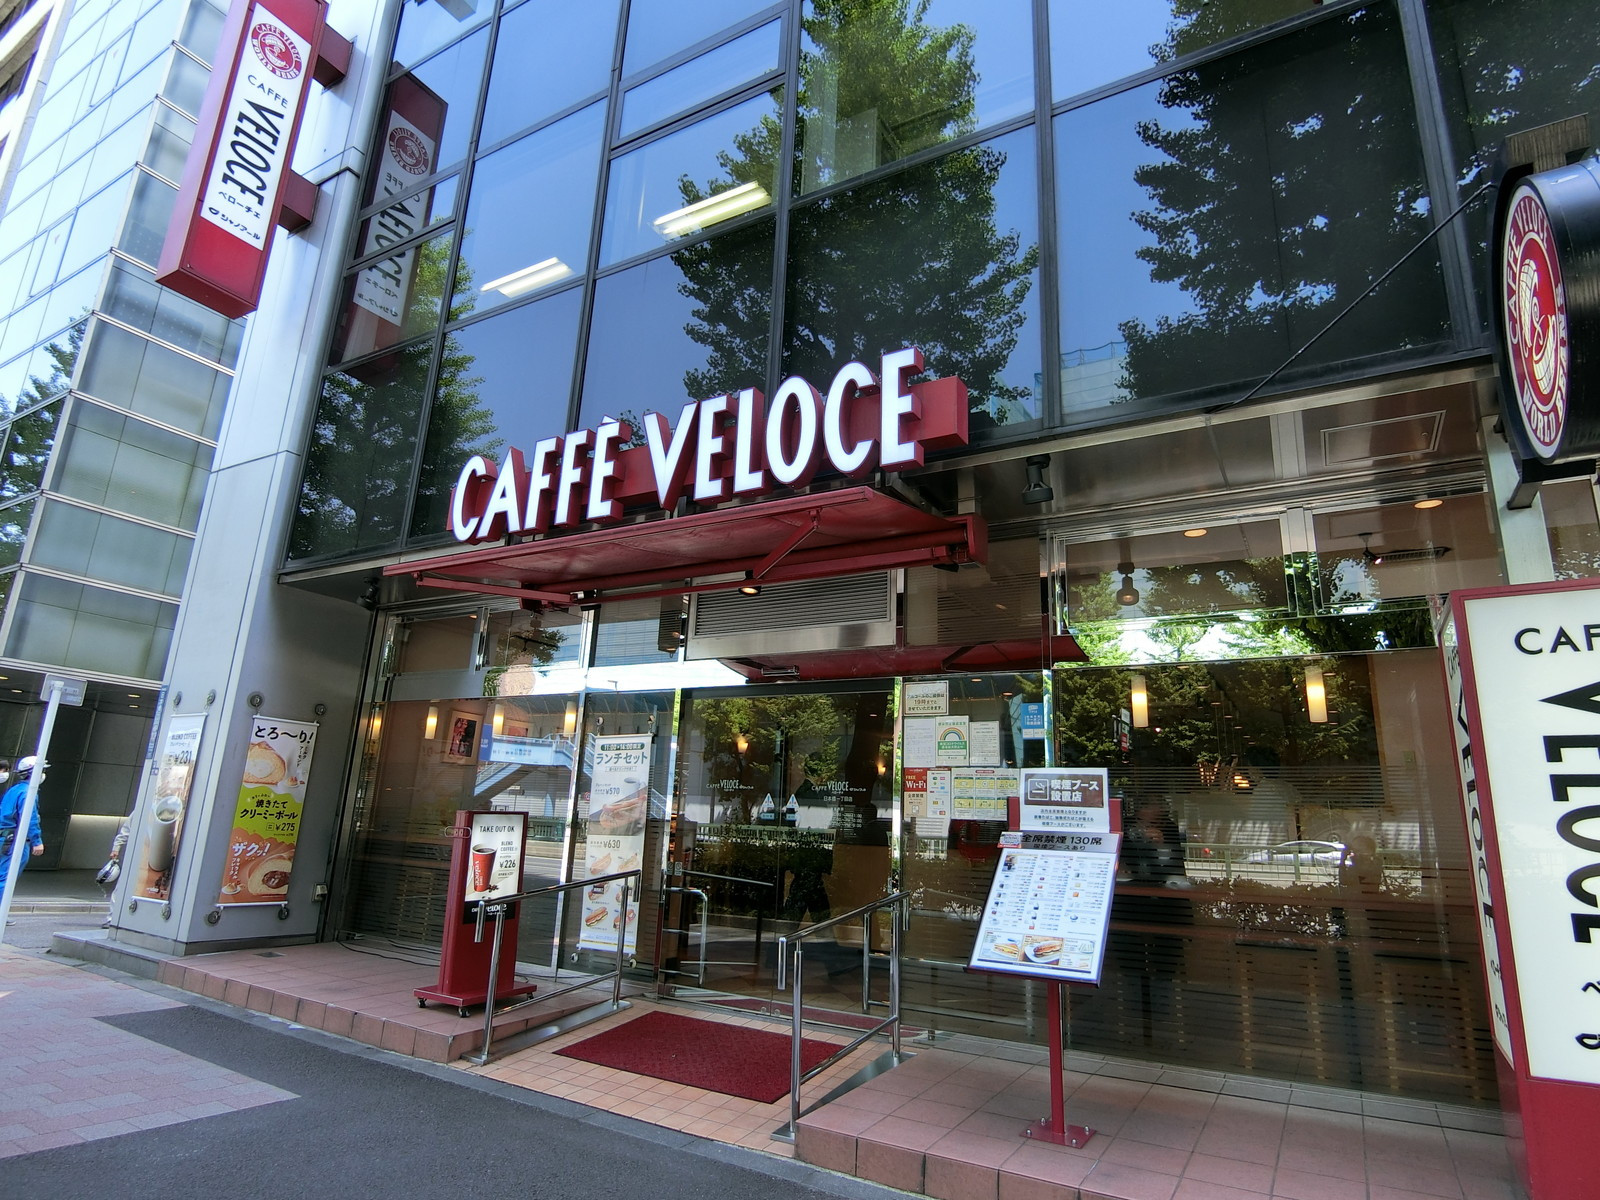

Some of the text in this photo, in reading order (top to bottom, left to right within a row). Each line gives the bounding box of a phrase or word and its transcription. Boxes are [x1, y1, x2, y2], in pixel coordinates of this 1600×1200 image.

[221, 98, 285, 206] VELOCE
[218, 190, 261, 219] ベローチェ
[220, 213, 261, 240] シャノアール
[1515, 199, 1548, 250] VELOCE
[1523, 378, 1556, 443] WORLD
[643, 347, 918, 512] VELOCE
[596, 752, 648, 765] ランチセット
[720, 779, 740, 789] VELOCE
[827, 781, 849, 791] VELOCE
[1051, 779, 1100, 791] 喫煙ブース
[1051, 791, 1083, 802] 設置店
[255, 799, 288, 809] 焼きたて
[240, 808, 298, 820] クリーミーボール
[275, 822, 295, 832] ¥275
[479, 825, 515, 833] TAKE OUT OK
[603, 839, 621, 849] ¥630
[1021, 834, 1067, 844] 全席禁煙
[500, 859, 517, 868] ¥226
